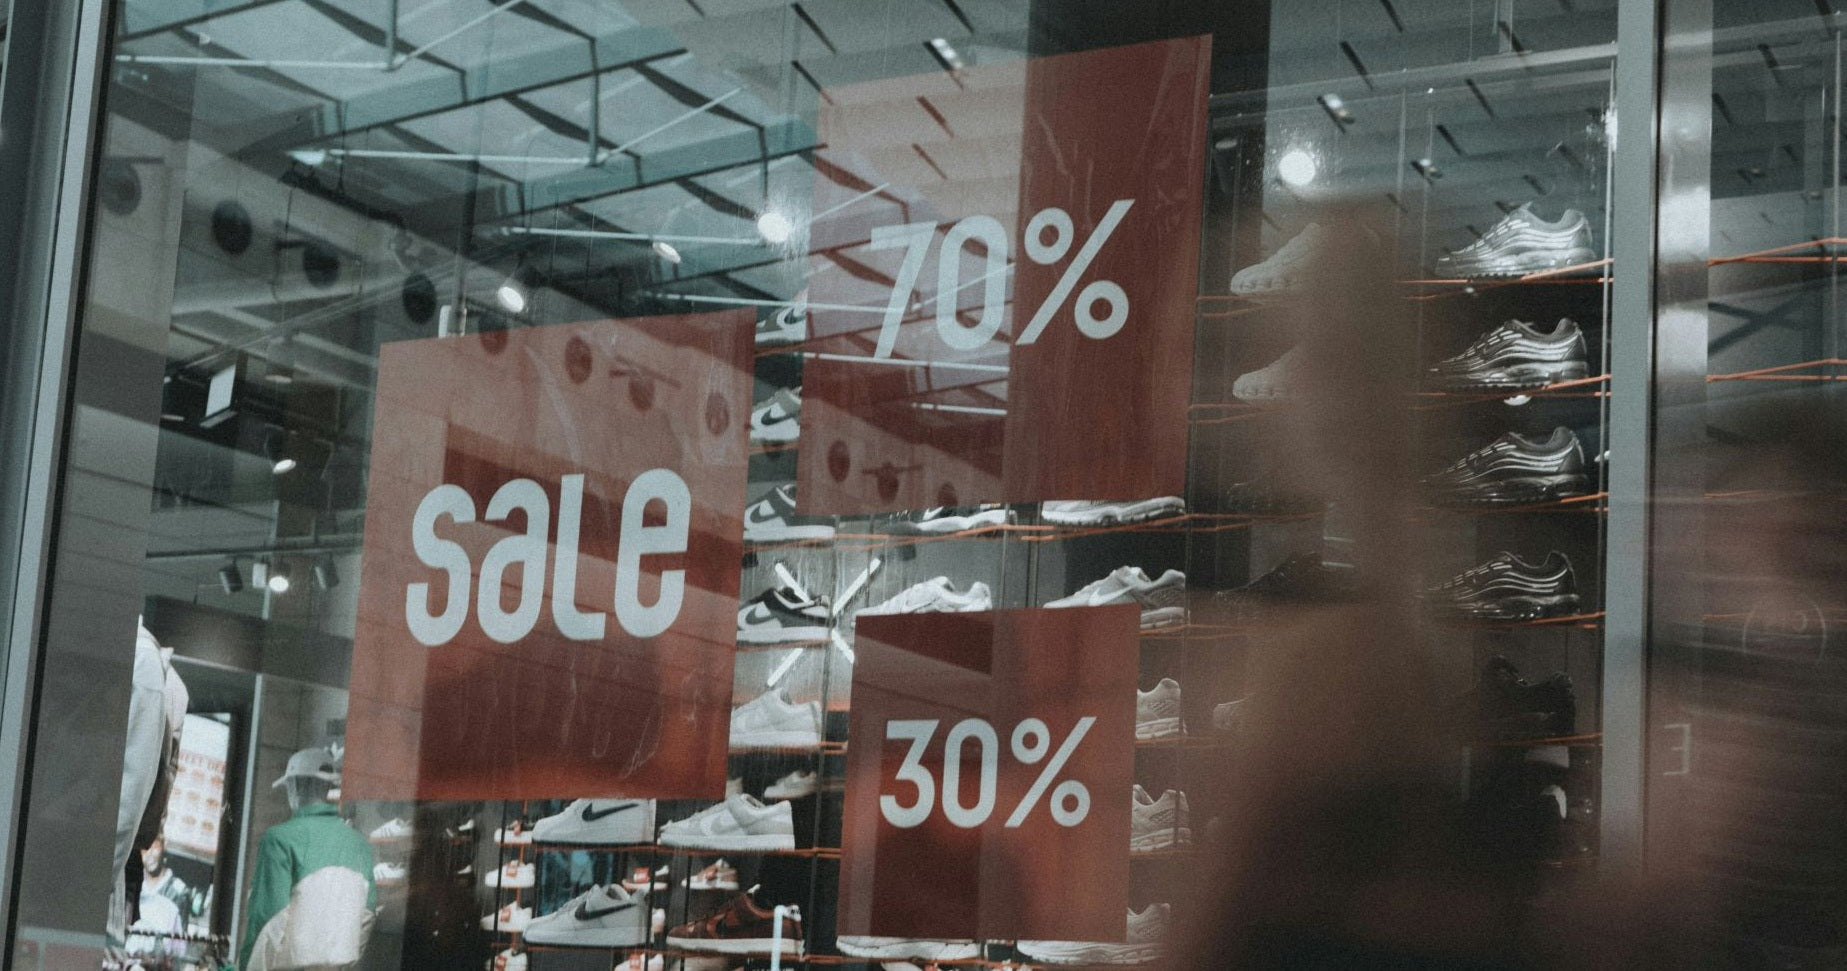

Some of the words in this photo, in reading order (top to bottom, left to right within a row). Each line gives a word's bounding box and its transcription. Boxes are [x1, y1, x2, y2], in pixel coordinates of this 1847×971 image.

[870, 199, 1135, 358] 70%
[405, 467, 692, 647] sale
[879, 716, 1097, 829] 30%
